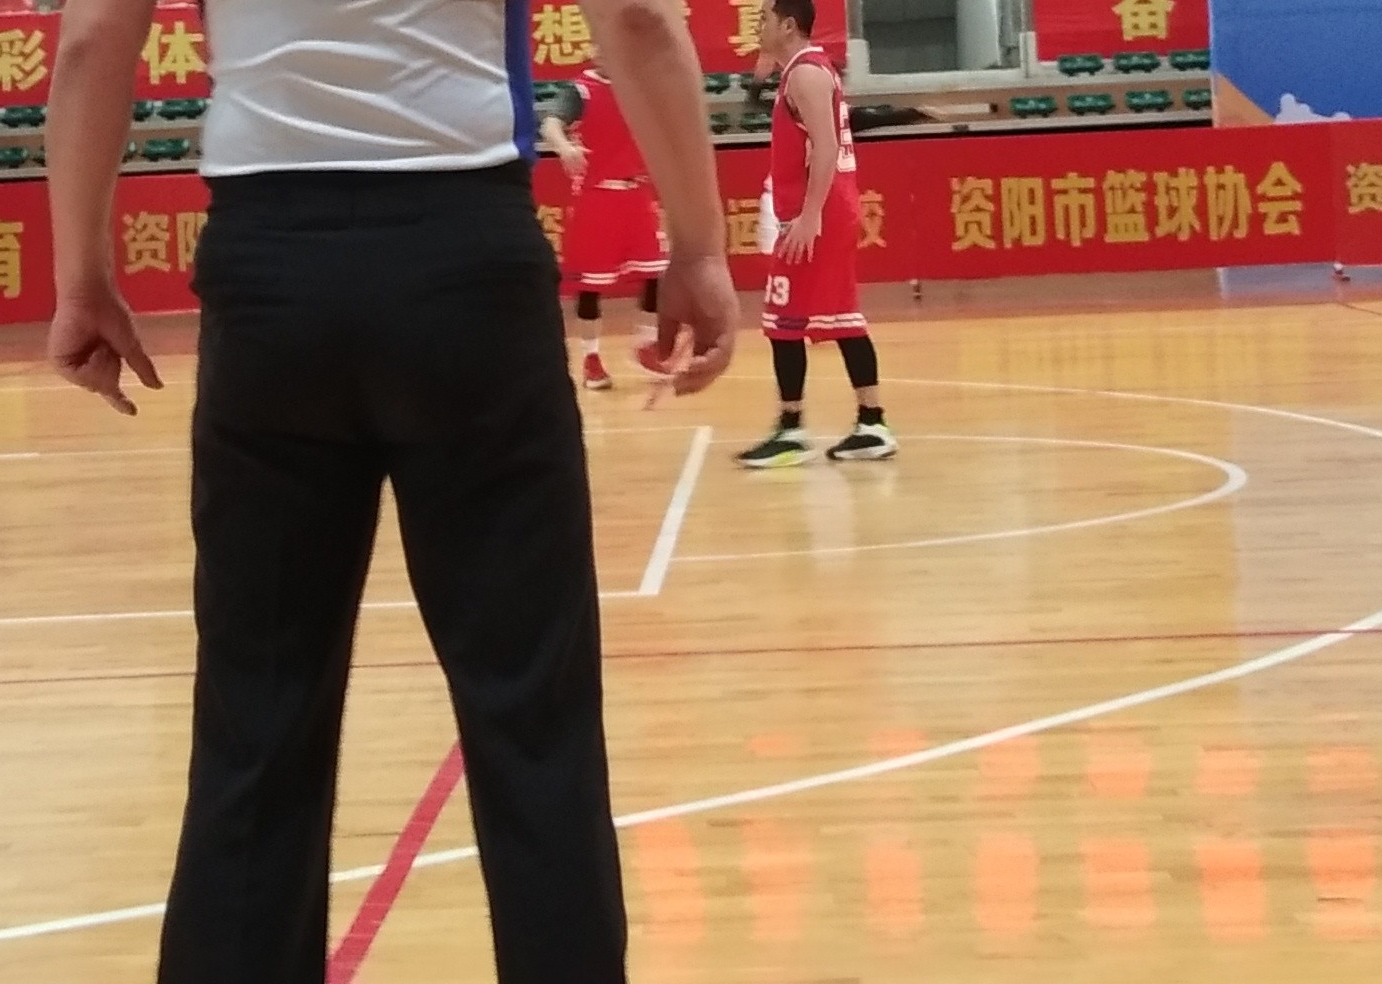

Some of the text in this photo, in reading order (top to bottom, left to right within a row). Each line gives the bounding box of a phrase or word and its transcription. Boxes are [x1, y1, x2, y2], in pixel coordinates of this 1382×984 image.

[949, 161, 1304, 251] 资阳市篮球协会
